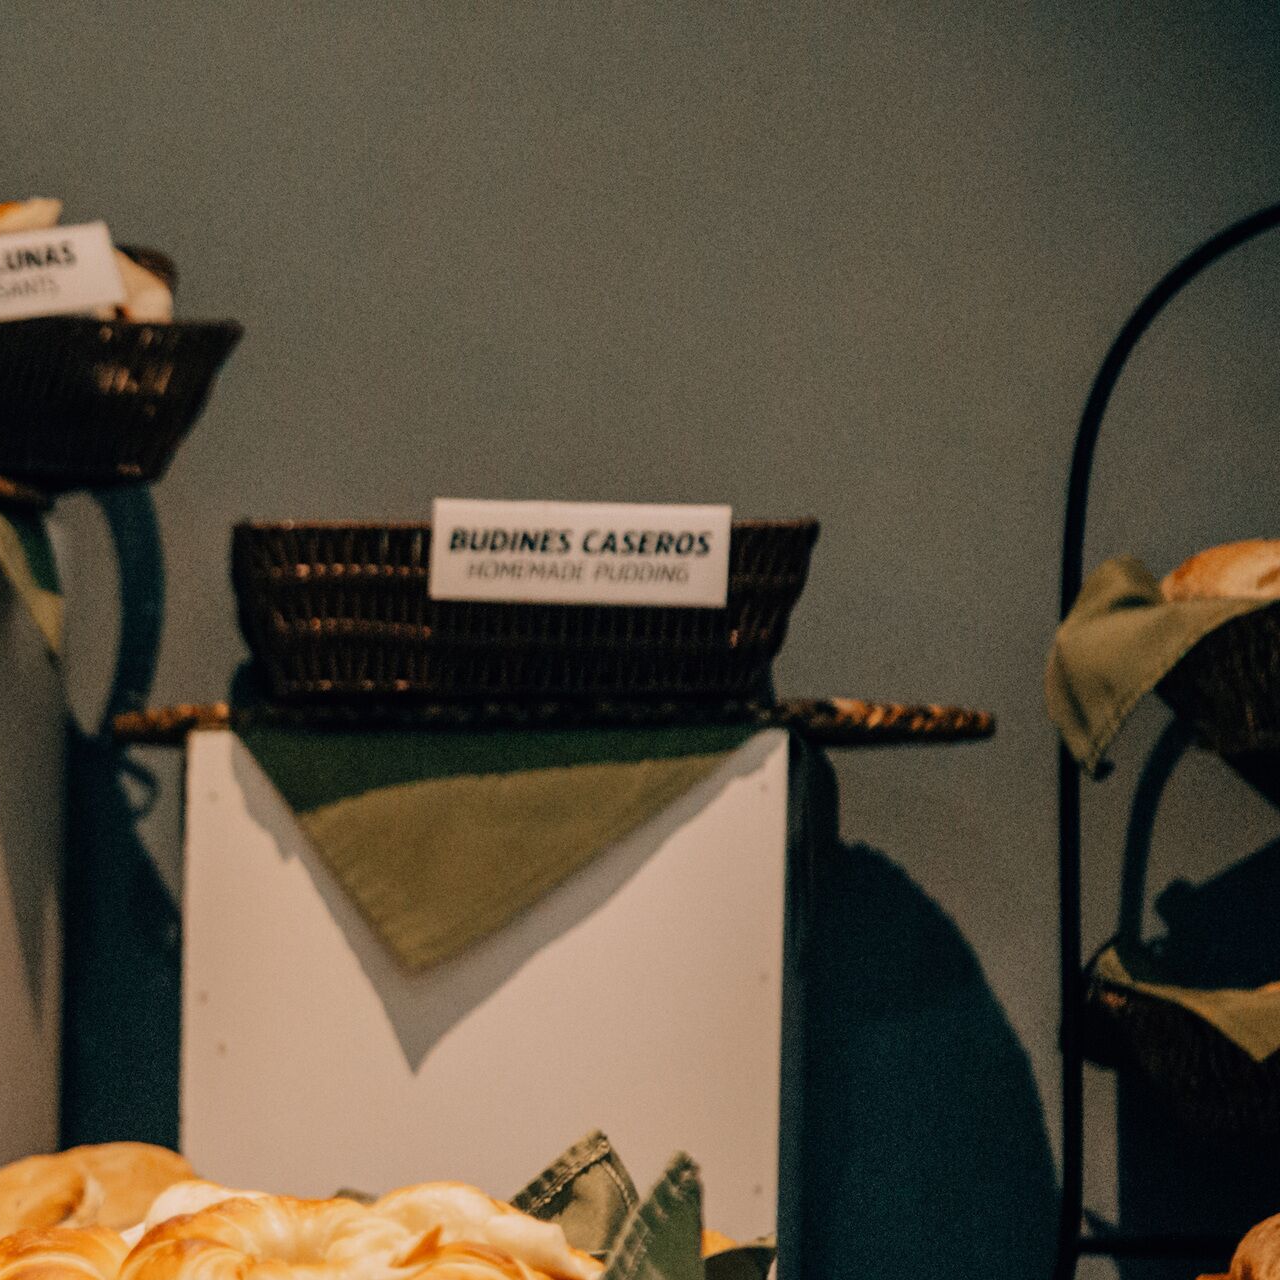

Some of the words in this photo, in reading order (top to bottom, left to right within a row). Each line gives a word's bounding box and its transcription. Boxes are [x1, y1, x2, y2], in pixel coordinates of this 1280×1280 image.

[449, 527, 572, 554] BUDINES
[581, 529, 713, 556] CASEROS
[467, 559, 584, 582] HOMEMADE
[593, 560, 691, 584] PUDDING
